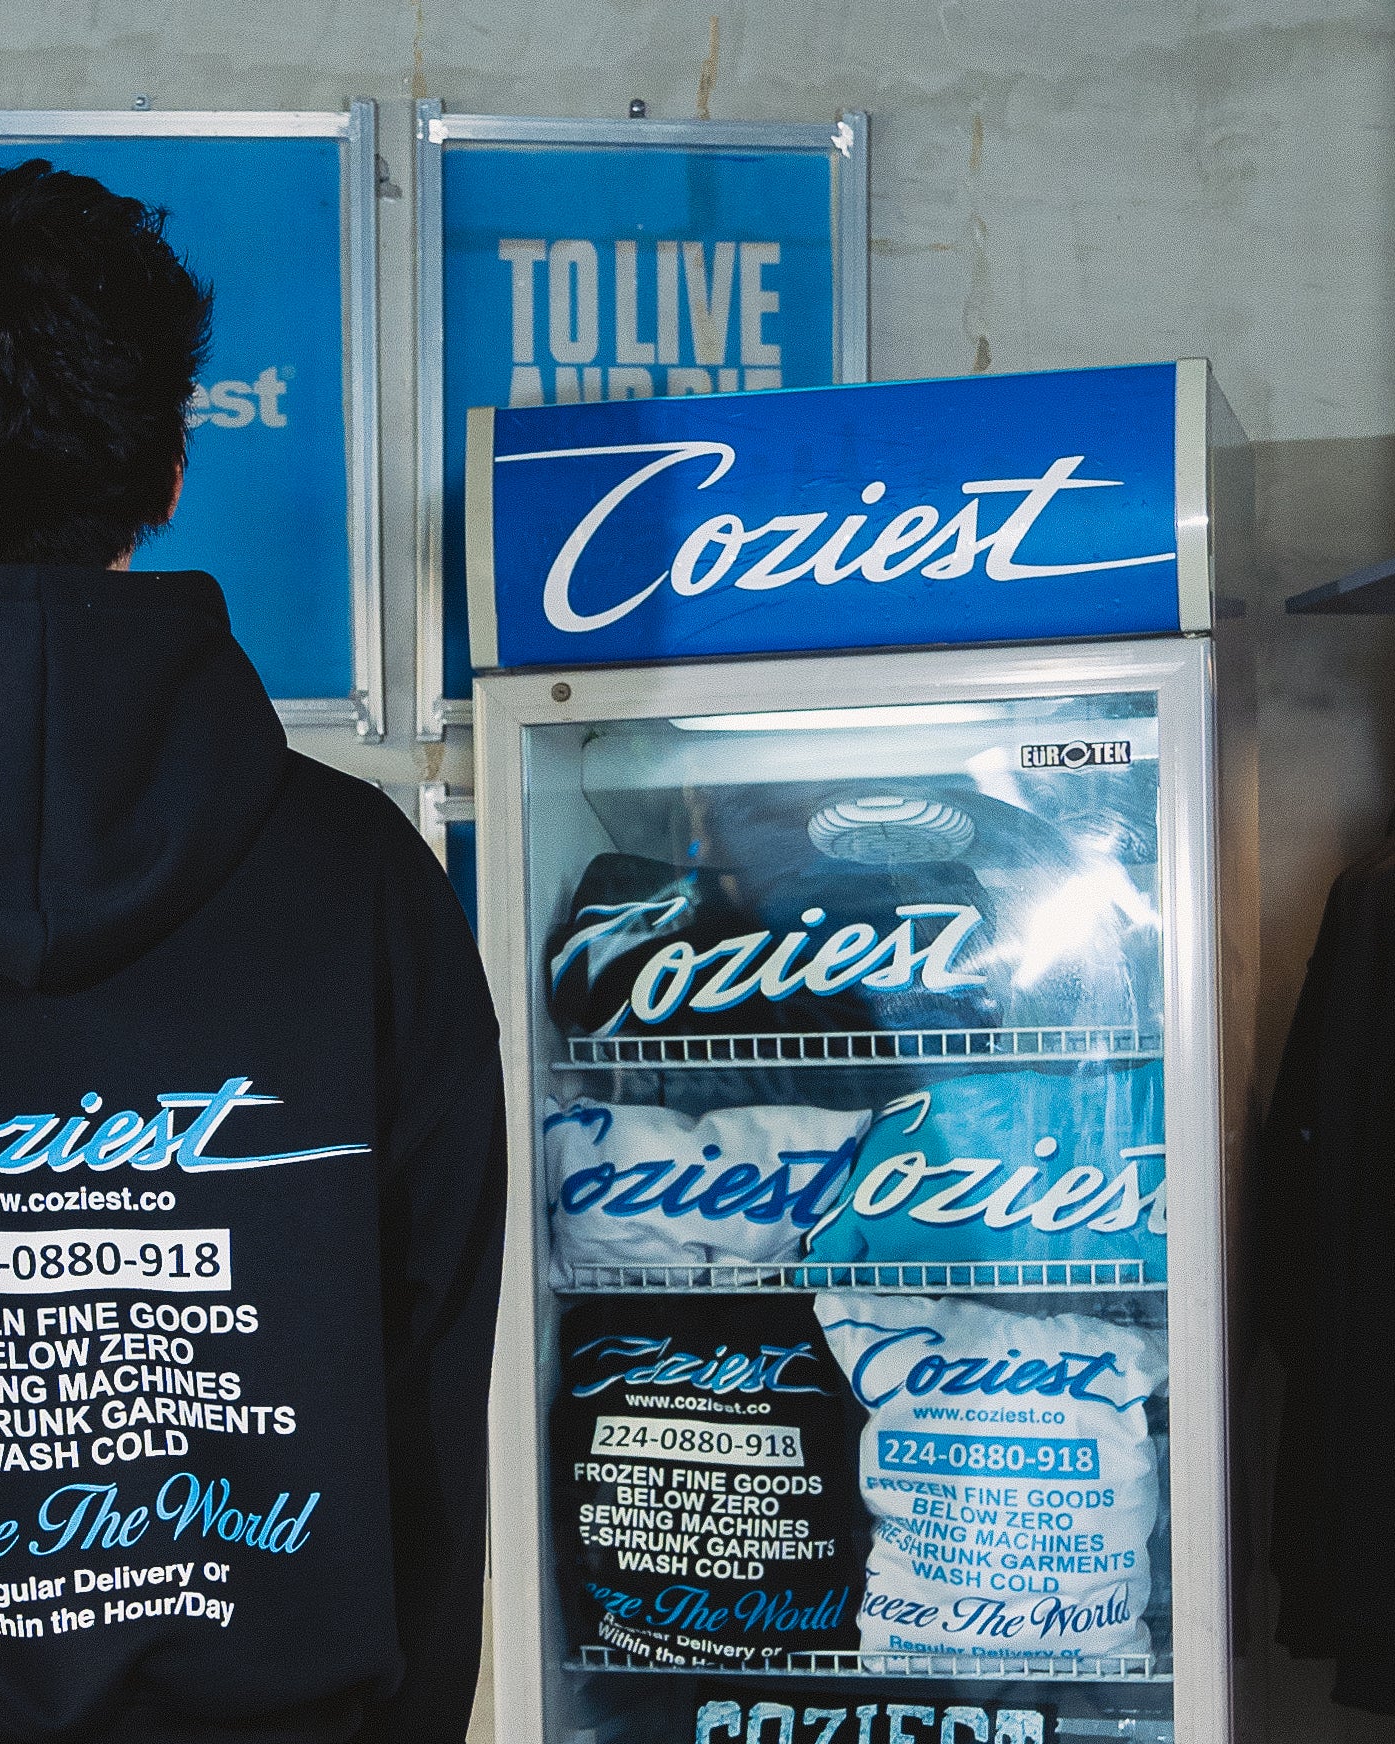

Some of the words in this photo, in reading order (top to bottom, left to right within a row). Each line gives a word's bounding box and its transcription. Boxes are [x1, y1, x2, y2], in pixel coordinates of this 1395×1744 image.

[498, 239, 599, 364] TO
[613, 240, 782, 366] LIVE
[494, 440, 1177, 633] Coziest
[37, 1302, 119, 1337] FINE
[129, 1302, 260, 1335] GOODS
[100, 1333, 195, 1365] ZERO
[822, 1318, 1151, 1412] Coziest
[59, 1364, 242, 1402] MACHINES
[101, 1397, 297, 1435] GARMENTS
[913, 1406, 1065, 1425] www.coziest.co
[91, 1429, 189, 1462] COLD
[598, 1424, 797, 1458] 224-0880-918
[883, 1438, 1094, 1473] 224-0880-918
[574, 1462, 665, 1487] FROZEN
[672, 1468, 726, 1492] FINE
[734, 1473, 823, 1496] GOODS
[866, 1476, 957, 1501] FROZEN
[964, 1486, 1017, 1508] FINE
[1028, 1488, 1116, 1509] GOODS
[28, 1482, 150, 1556] The
[155, 1472, 321, 1556] World
[617, 1486, 705, 1513] BELOW
[711, 1493, 780, 1516] ZERO
[912, 1497, 997, 1526] BELOW
[1005, 1511, 1074, 1532] ZERO
[579, 1504, 674, 1531] SEWING
[681, 1513, 809, 1539] MACHINES
[975, 1529, 1105, 1553] MACHINES
[74, 1560, 195, 1594] Delivery
[204, 1563, 231, 1583] or
[618, 1551, 688, 1577] WASH
[695, 1559, 764, 1581] COLD
[912, 1560, 981, 1589] WASH
[990, 1572, 1060, 1594] COLD
[1001, 1550, 1136, 1575] GARMENTS
[51, 1605, 96, 1635] the
[104, 1591, 236, 1628] Hour/Day
[645, 1584, 730, 1633] The
[734, 1585, 849, 1633] World
[941, 1596, 1025, 1639] The
[1030, 1580, 1131, 1640] World
[598, 1620, 651, 1658] Within
[655, 1646, 686, 1667] the
[676, 1634, 756, 1661] Delivery
[761, 1646, 783, 1657] or
